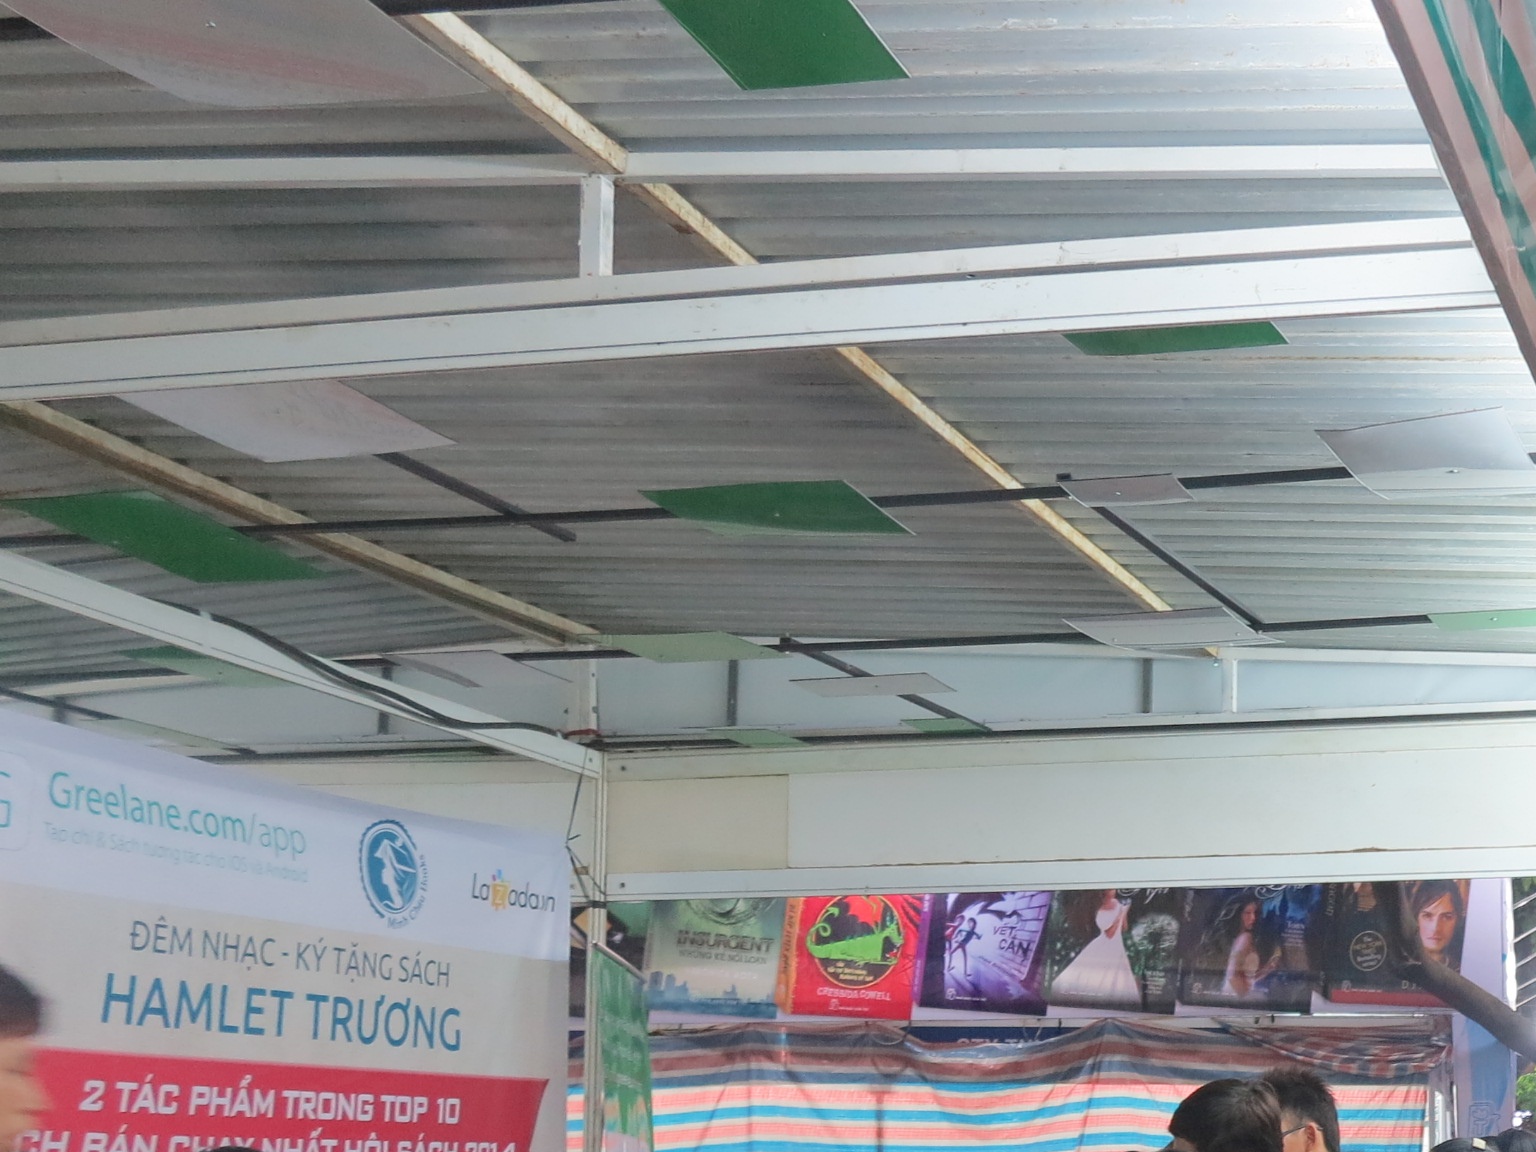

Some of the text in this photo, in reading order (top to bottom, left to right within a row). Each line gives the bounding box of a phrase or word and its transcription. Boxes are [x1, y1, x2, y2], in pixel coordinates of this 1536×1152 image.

[49, 771, 306, 861] Greelane.com/app
[130, 916, 193, 955] ĐÊM
[202, 929, 276, 972] NHẠC
[296, 937, 327, 972] KÝ
[333, 942, 392, 984] TẶNG
[399, 951, 450, 988] SÁCH
[101, 972, 461, 1052] HAMLET TRƯƠNG
[817, 986, 860, 1000] CRESSIDA
[79, 1074, 461, 1125] 2 TÁC PHẨM TRONG TOP 10
